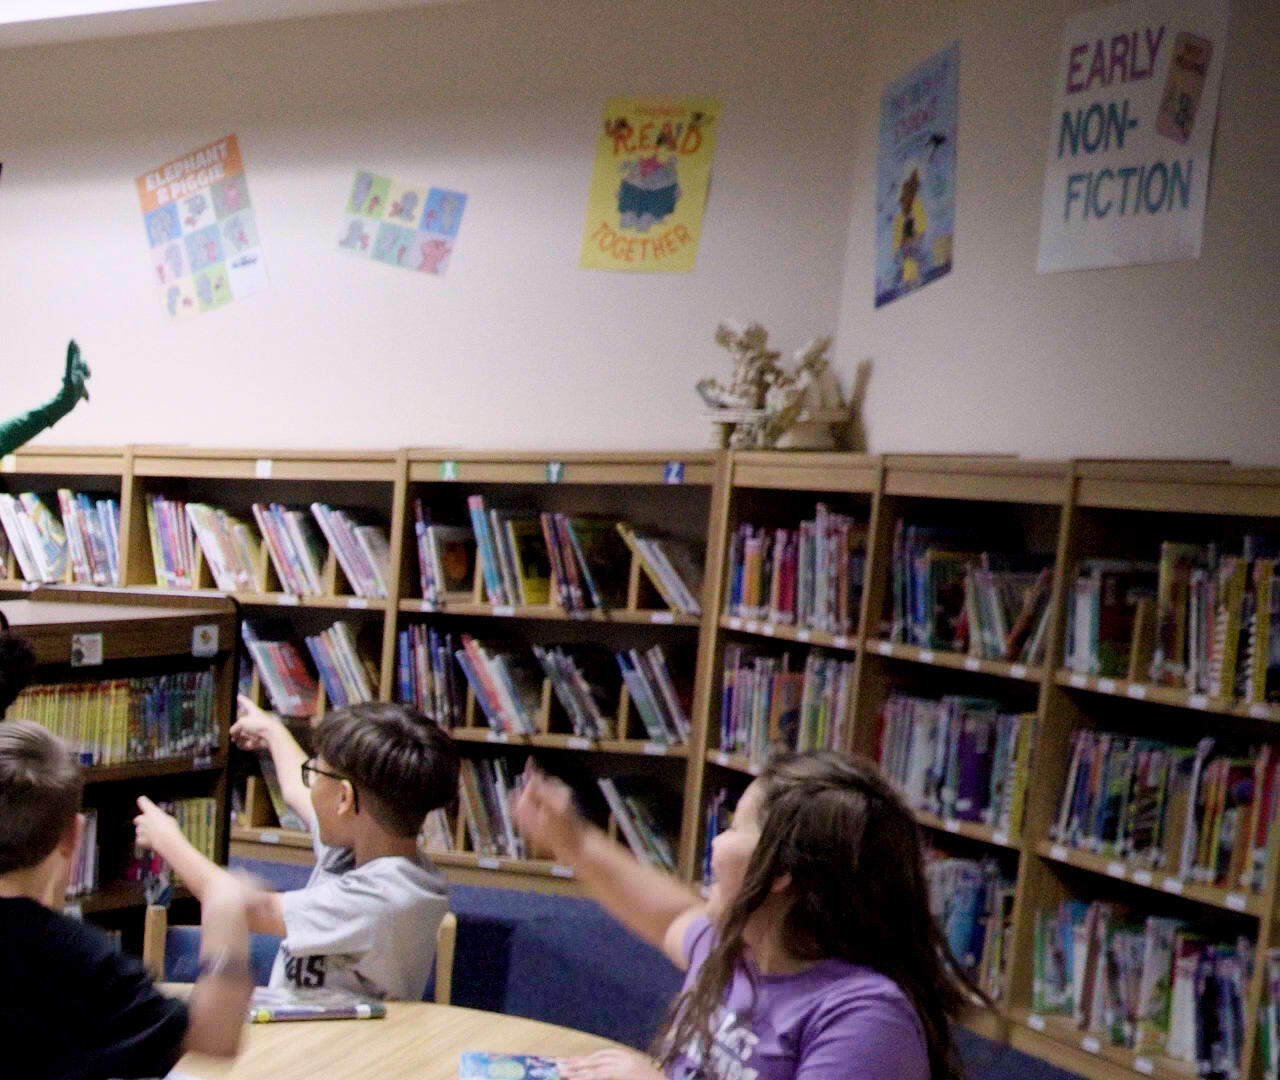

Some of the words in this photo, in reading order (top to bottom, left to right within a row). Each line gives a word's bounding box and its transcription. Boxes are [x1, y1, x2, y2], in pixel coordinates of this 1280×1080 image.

[1066, 27, 1165, 94] EARLY
[609, 120, 703, 156] READ
[1057, 100, 1138, 159] NON-
[144, 143, 229, 192] ELEPHANT
[1064, 160, 1194, 223] FICTION
[592, 219, 692, 262] TOGETHER
